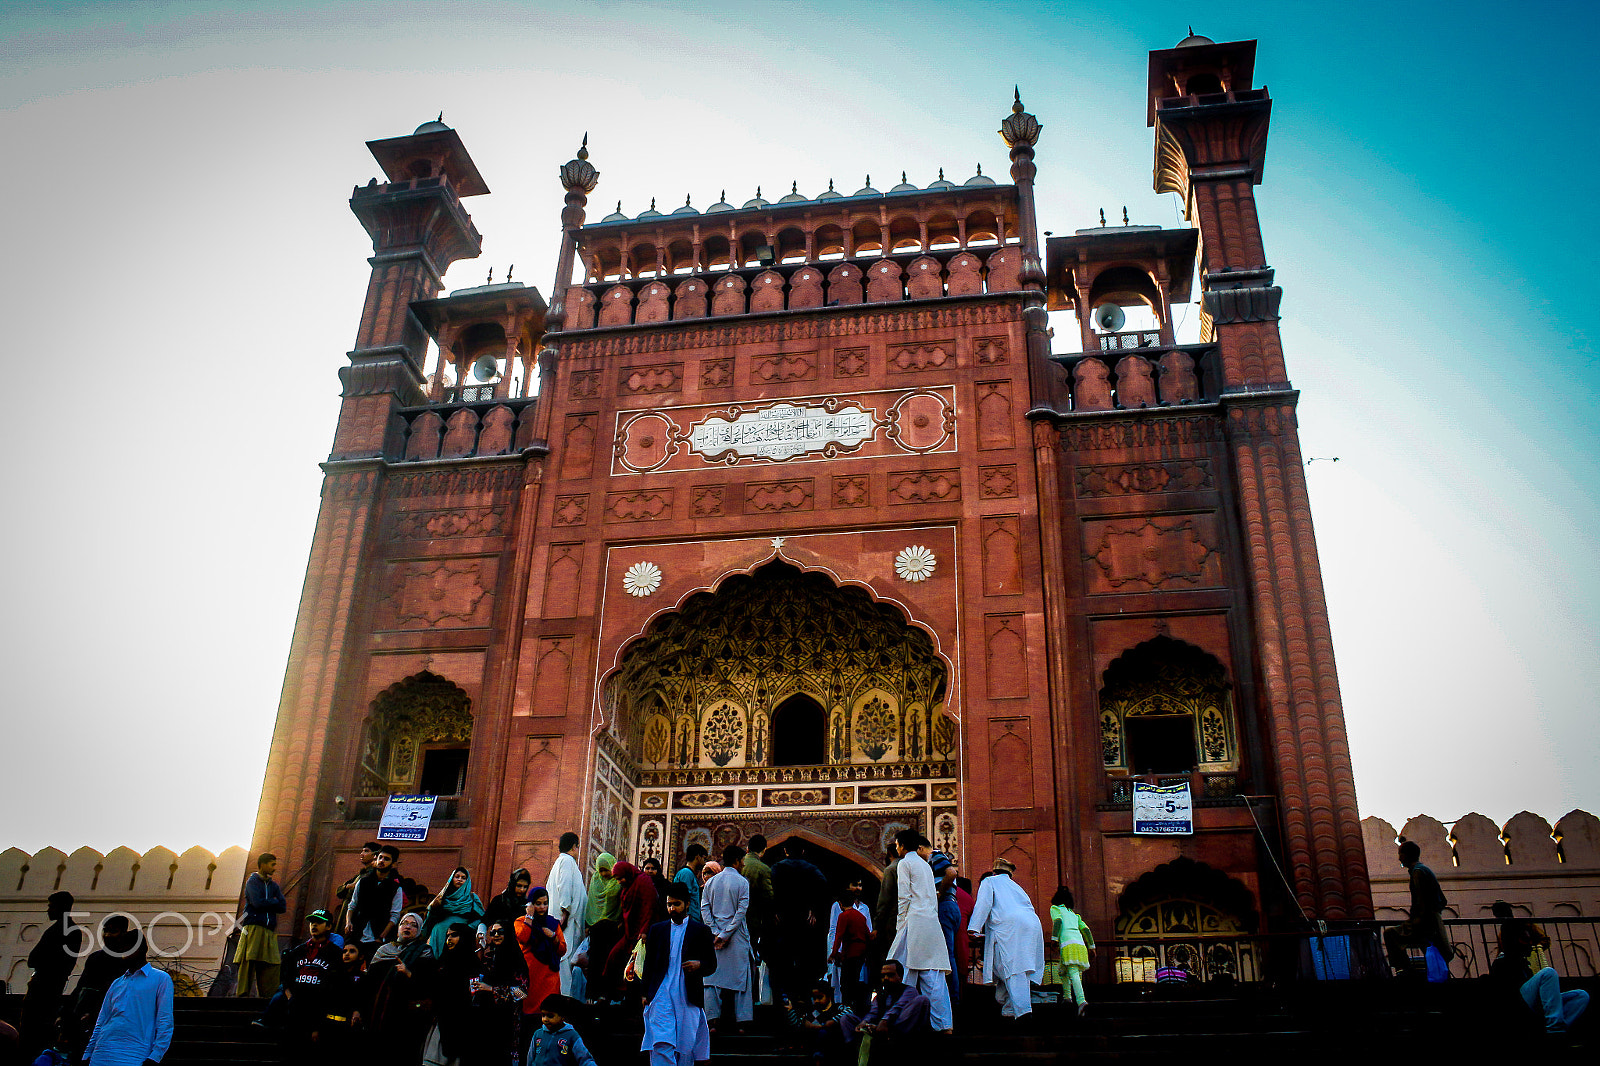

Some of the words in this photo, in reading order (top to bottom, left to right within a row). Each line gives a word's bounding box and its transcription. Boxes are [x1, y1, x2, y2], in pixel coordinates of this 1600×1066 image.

[1165, 801, 1175, 813] 5
[408, 812, 418, 821] 5
[298, 974, 318, 985] 1998
